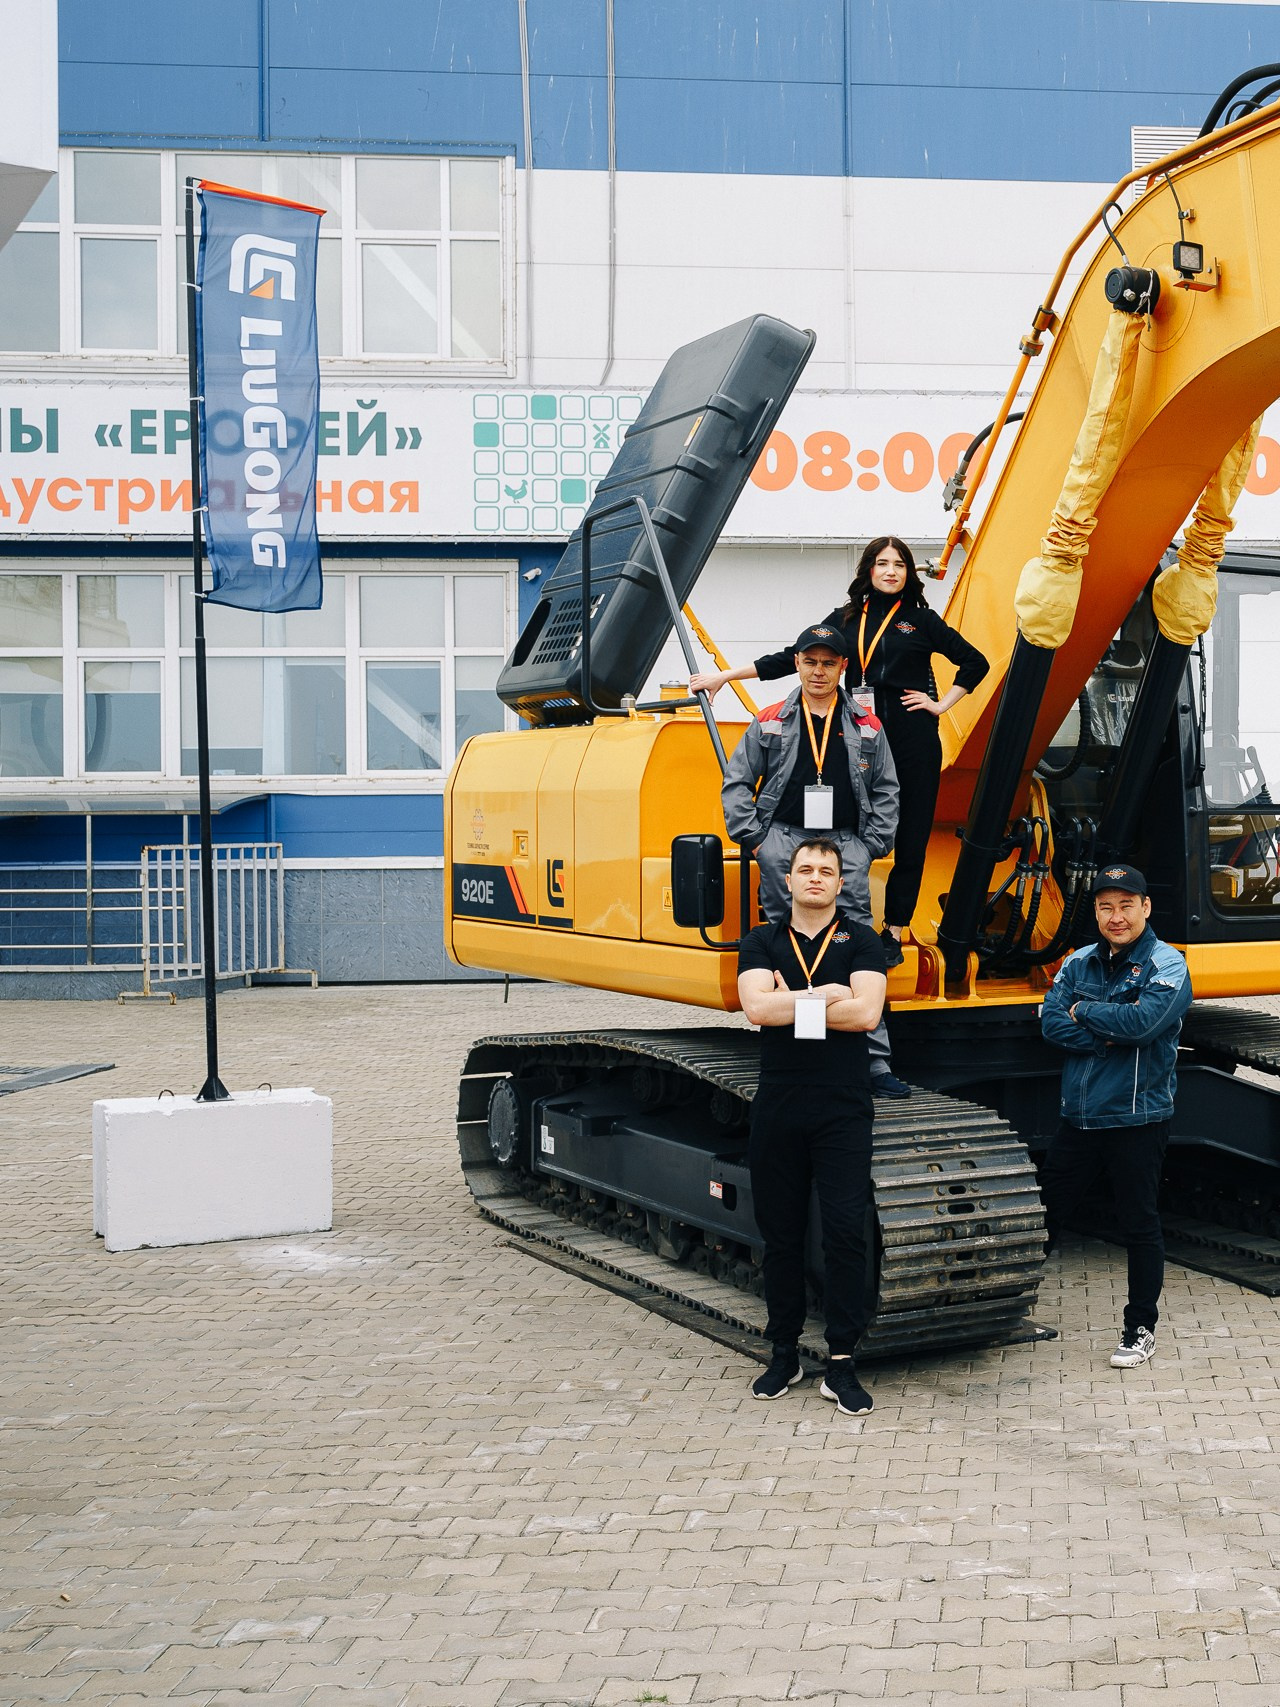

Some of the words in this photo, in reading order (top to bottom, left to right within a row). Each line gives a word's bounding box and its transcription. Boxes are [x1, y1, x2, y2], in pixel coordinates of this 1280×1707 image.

[0, 408, 59, 454] Ы
[240, 316, 287, 569] LIUGONG
[461, 878, 494, 904] 920E
